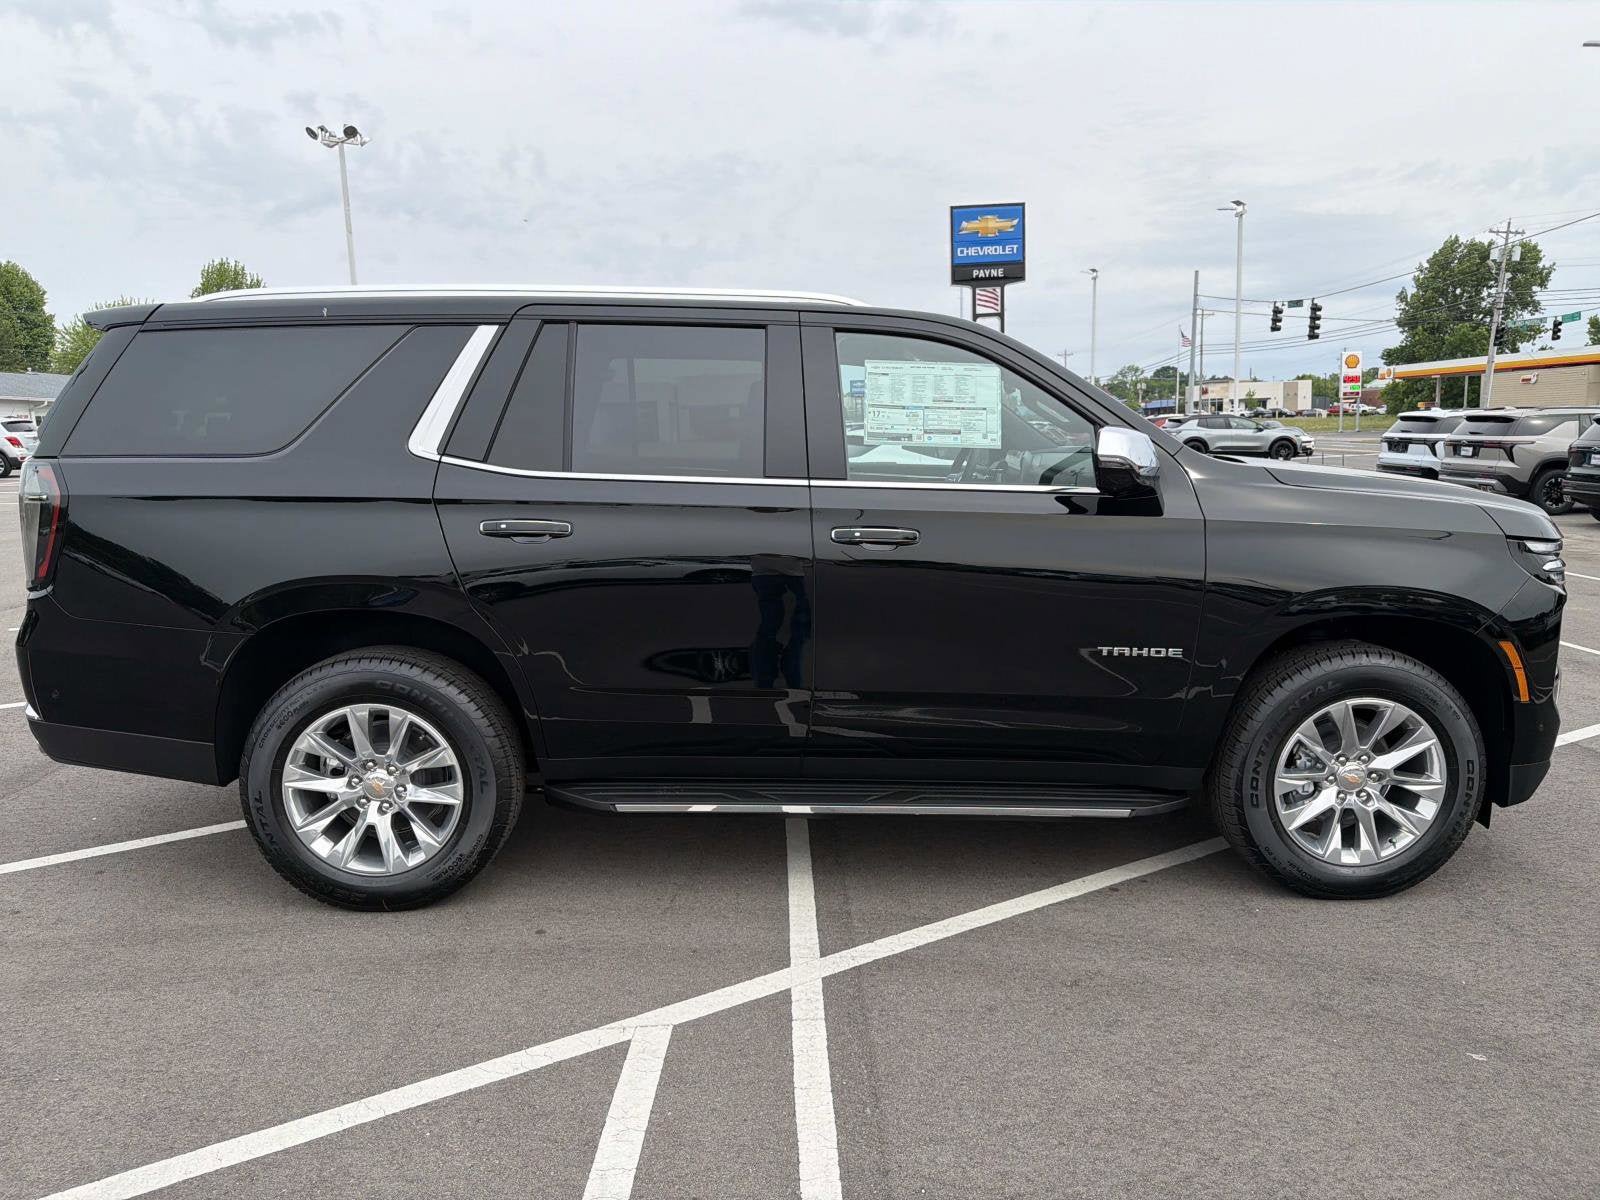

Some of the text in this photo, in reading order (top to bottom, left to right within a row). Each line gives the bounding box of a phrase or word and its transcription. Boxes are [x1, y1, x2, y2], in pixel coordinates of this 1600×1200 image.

[957, 244, 1018, 257] CHEVROLET
[972, 268, 1004, 278] PAYNE
[1097, 646, 1183, 658] TAHOE
